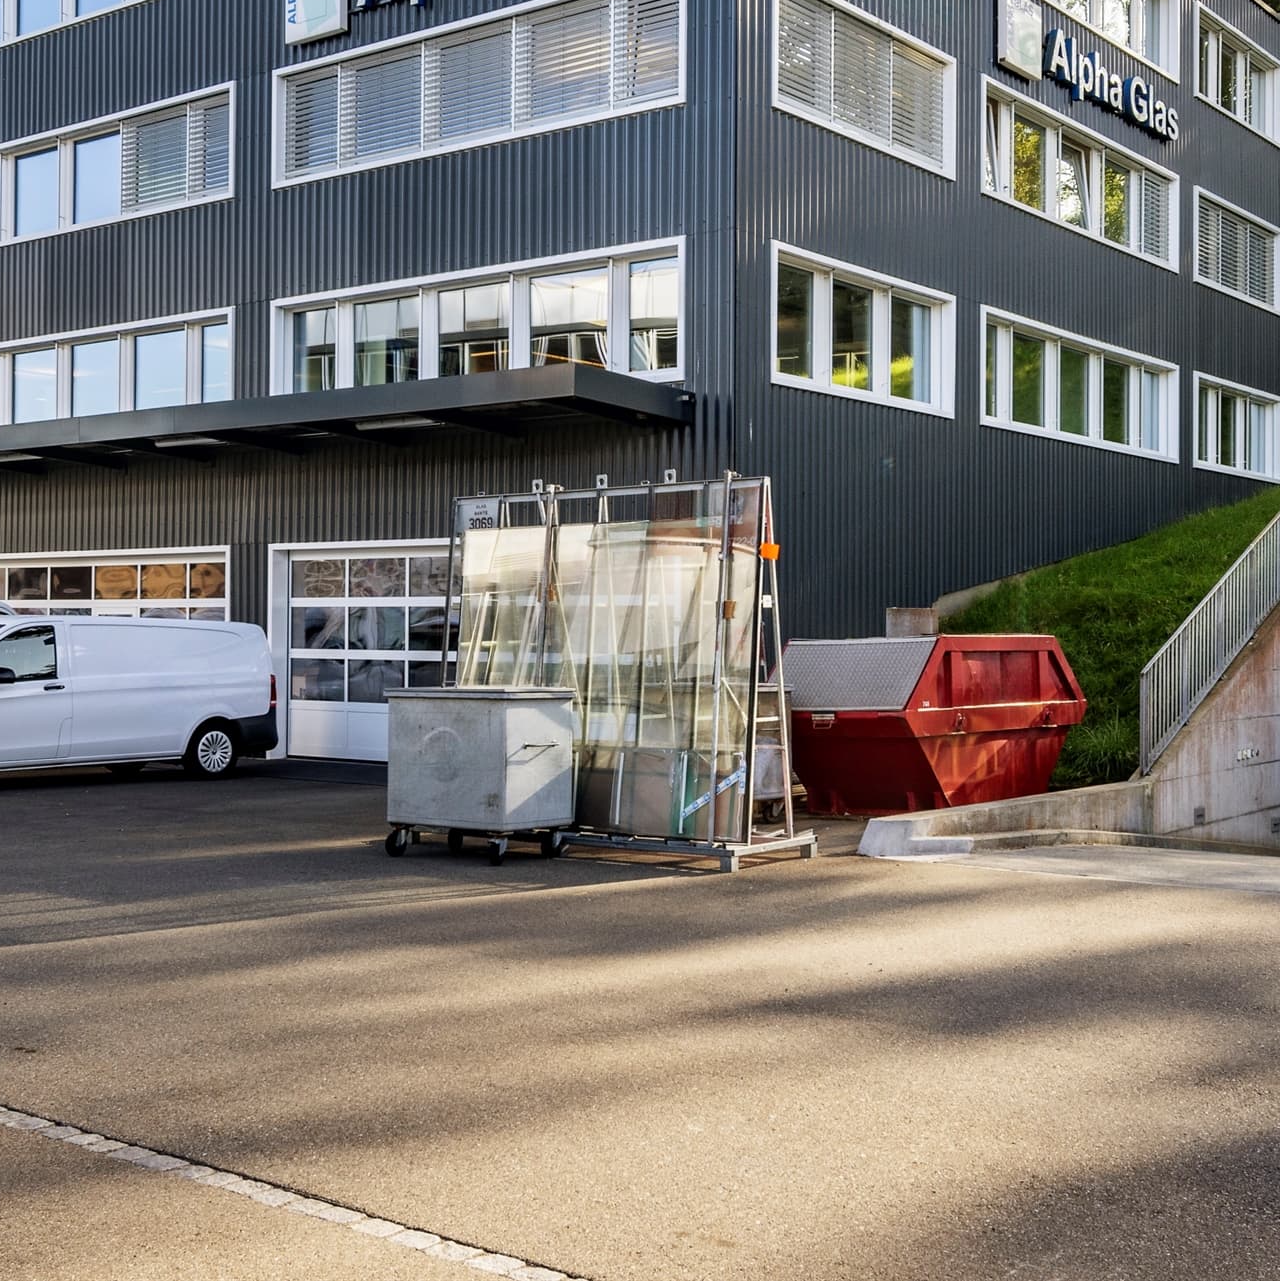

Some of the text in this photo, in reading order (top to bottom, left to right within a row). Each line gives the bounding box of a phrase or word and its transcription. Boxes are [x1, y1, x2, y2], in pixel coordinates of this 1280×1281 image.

[1047, 28, 1179, 141] Alpha Glas
[469, 517, 493, 529] 3069
